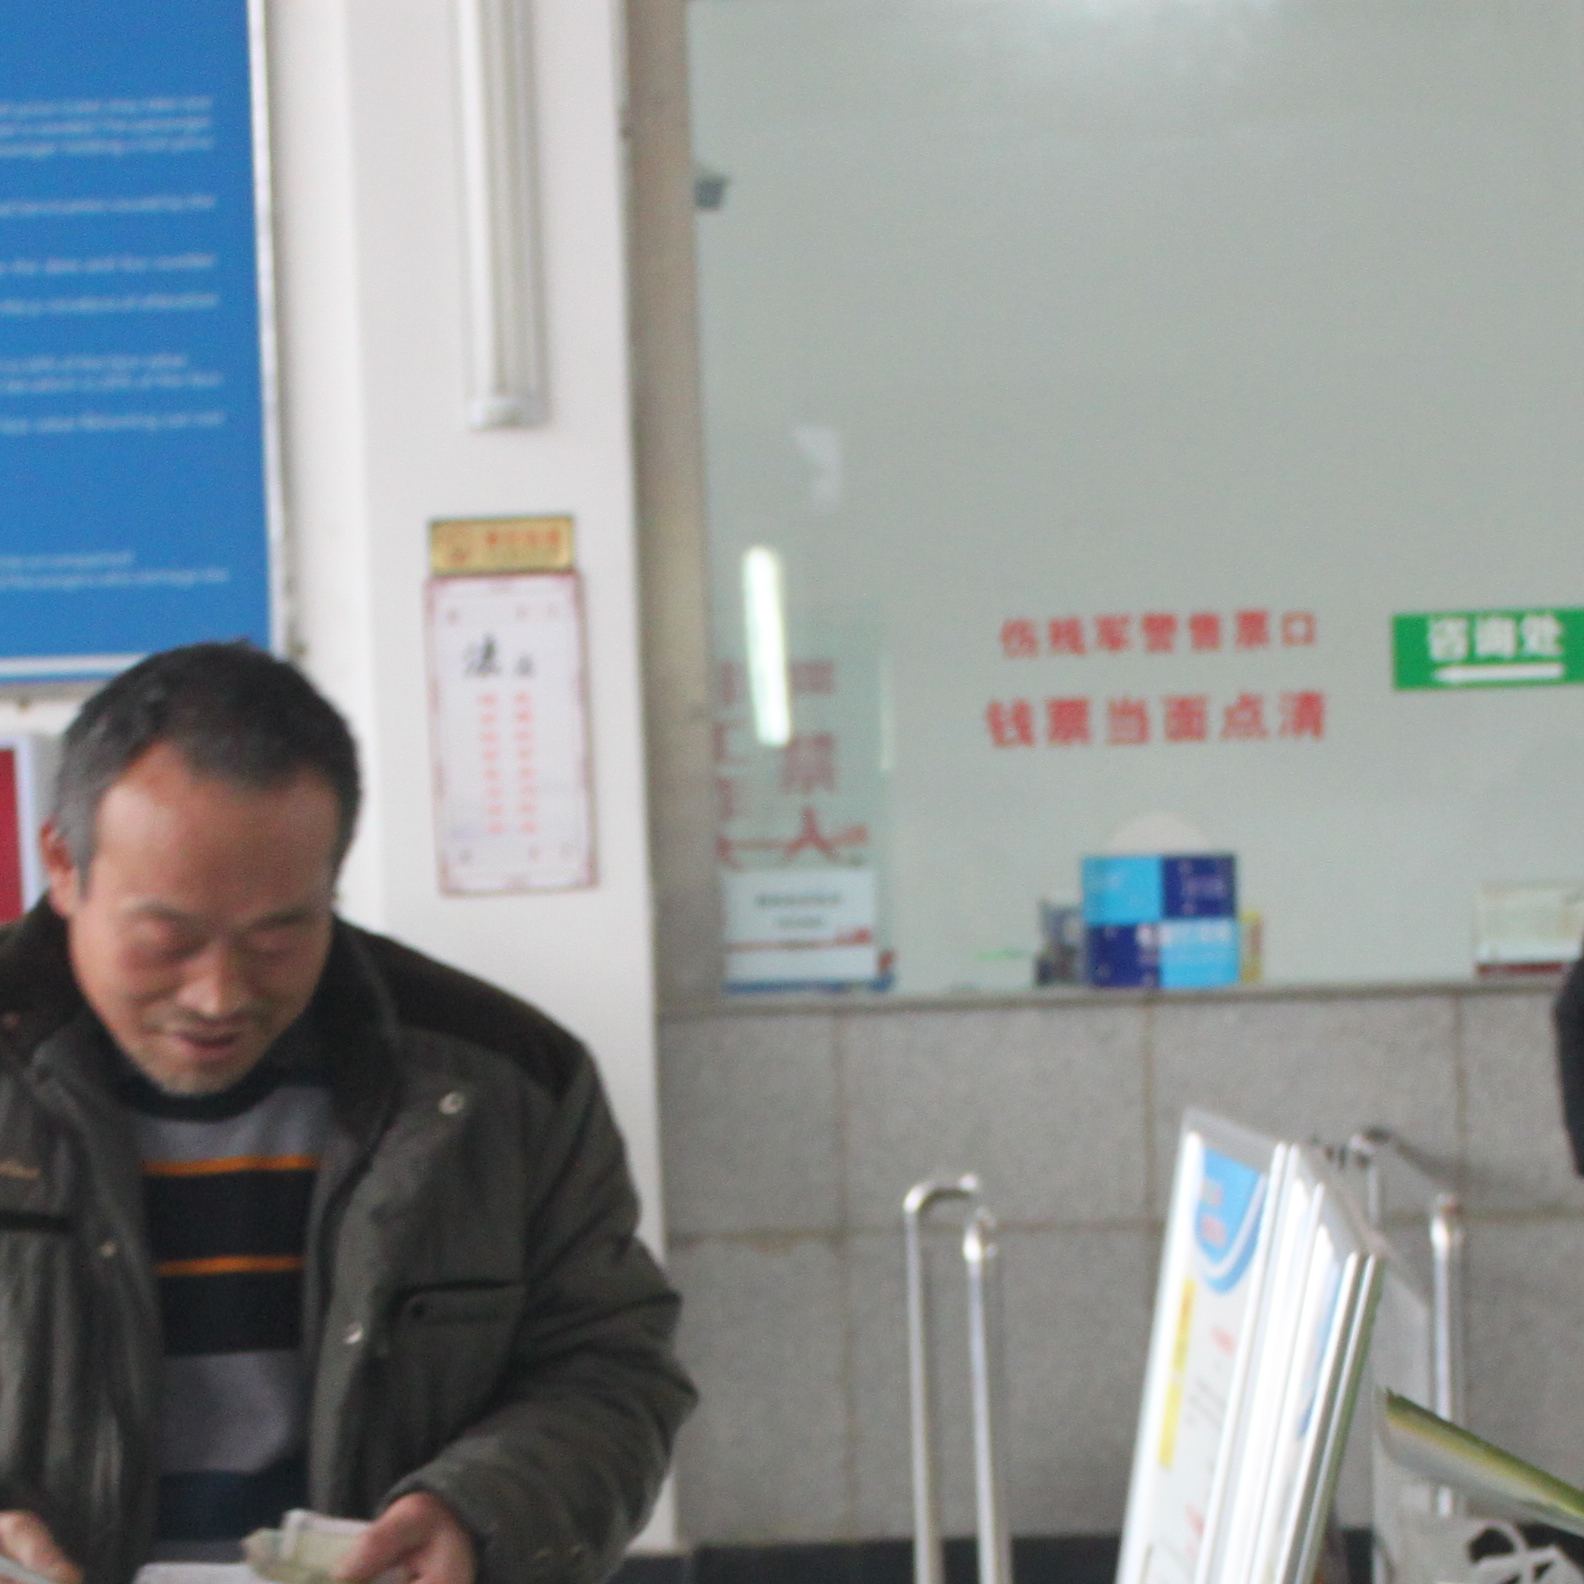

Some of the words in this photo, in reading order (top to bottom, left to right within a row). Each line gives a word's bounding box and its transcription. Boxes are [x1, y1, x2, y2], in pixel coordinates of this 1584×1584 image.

[986, 690, 1325, 747] 钱票当面点清
